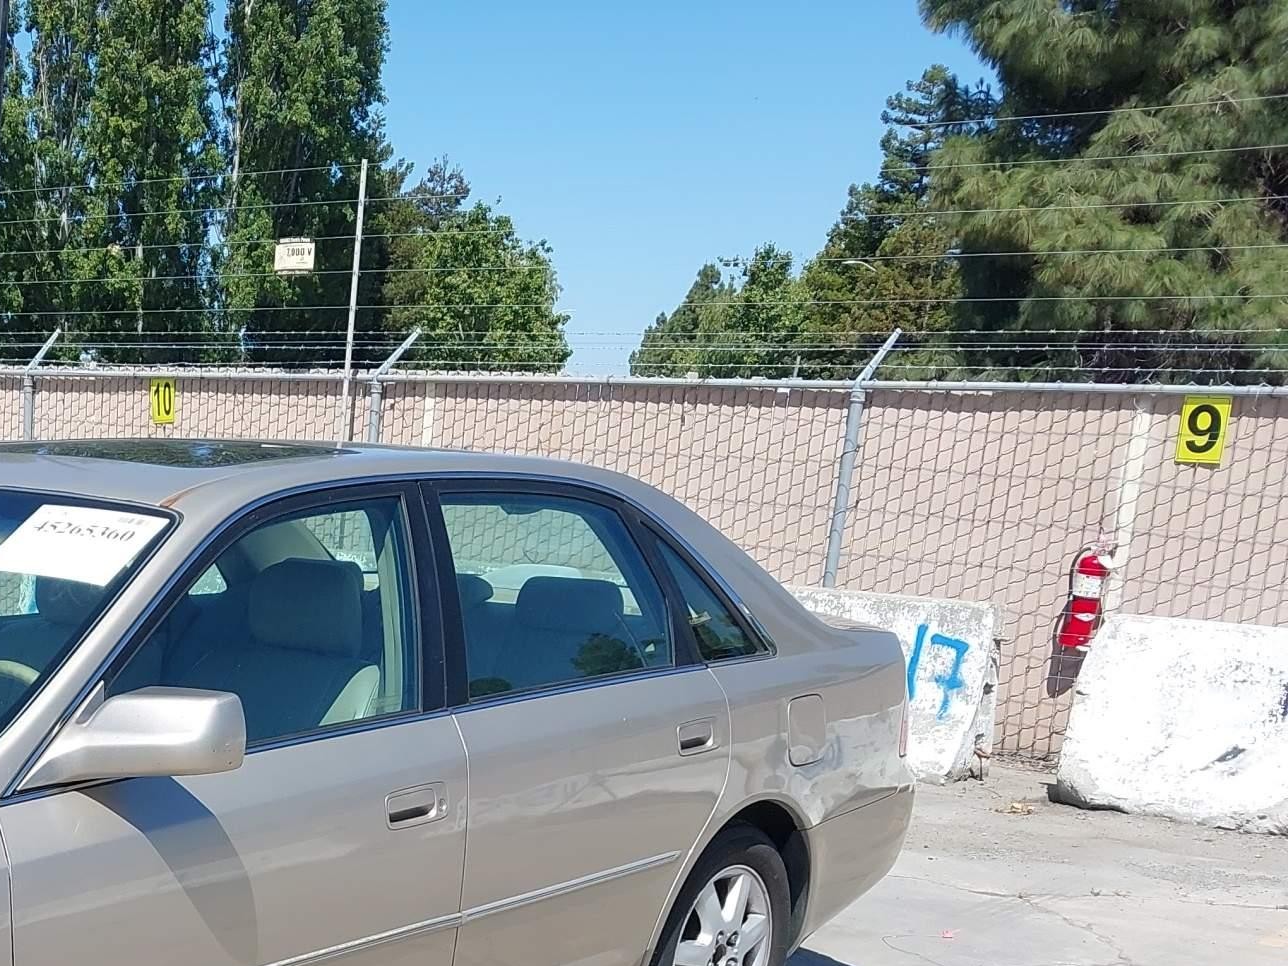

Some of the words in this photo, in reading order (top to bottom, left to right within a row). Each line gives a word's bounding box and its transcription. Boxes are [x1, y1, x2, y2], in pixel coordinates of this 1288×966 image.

[154, 381, 172, 416] 10
[1185, 404, 1222, 453] 9
[907, 623, 969, 720] 17
